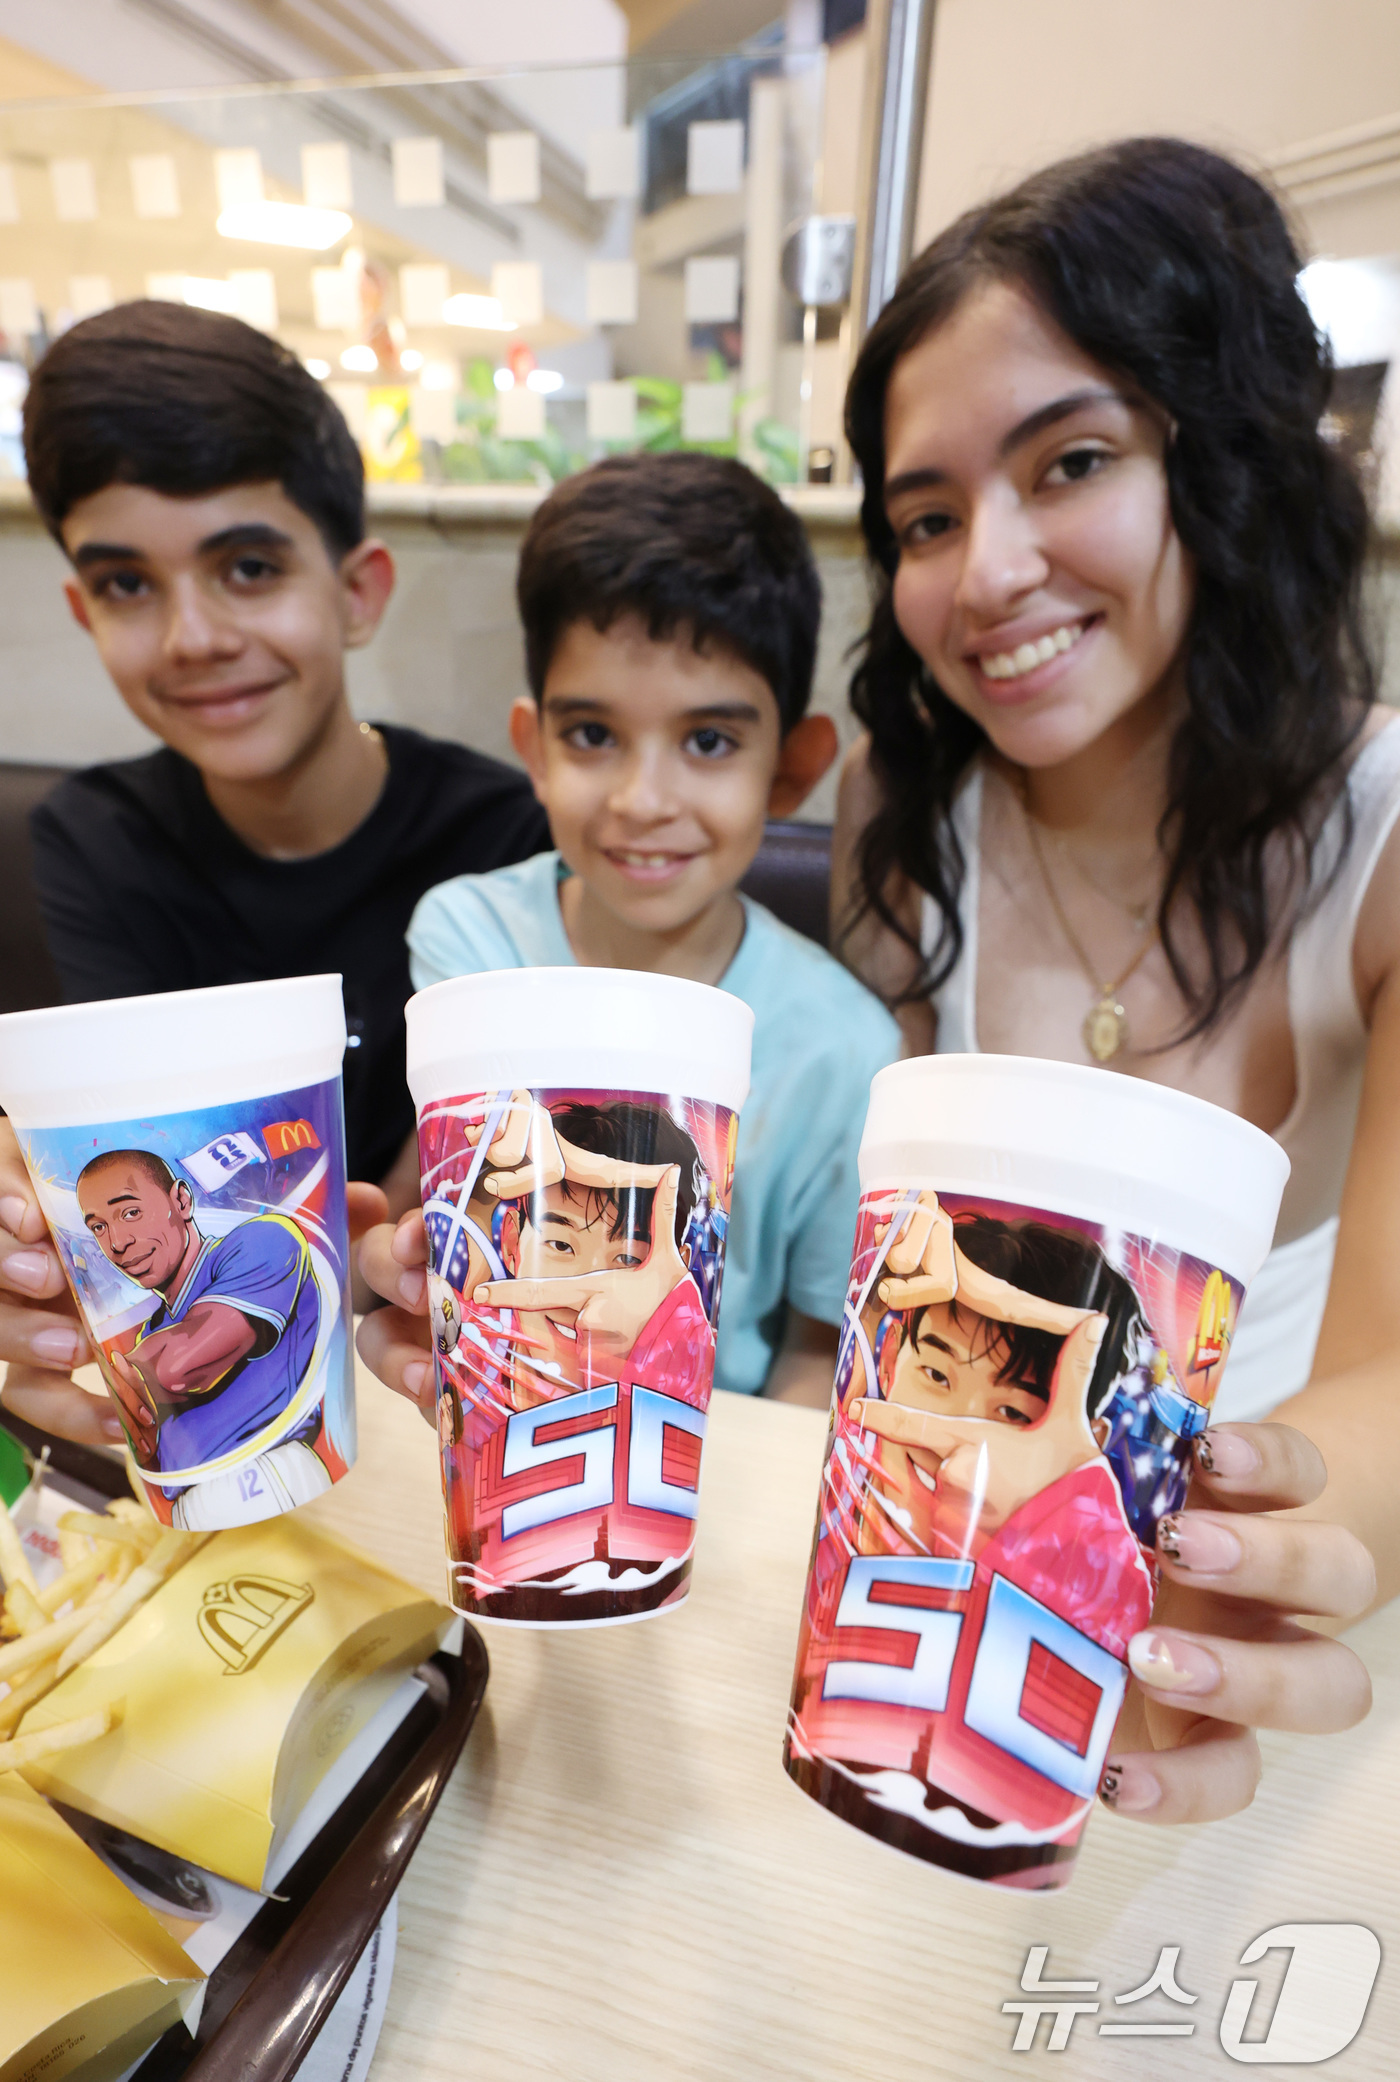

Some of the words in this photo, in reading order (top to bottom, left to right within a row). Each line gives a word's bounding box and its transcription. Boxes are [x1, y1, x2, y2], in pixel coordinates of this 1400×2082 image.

[236, 1469, 264, 1502] 12
[348, 2047, 358, 2061] de
[353, 2013, 368, 2046] puntos
[362, 1977, 374, 2011] vigente
[370, 1963, 377, 1976] en
